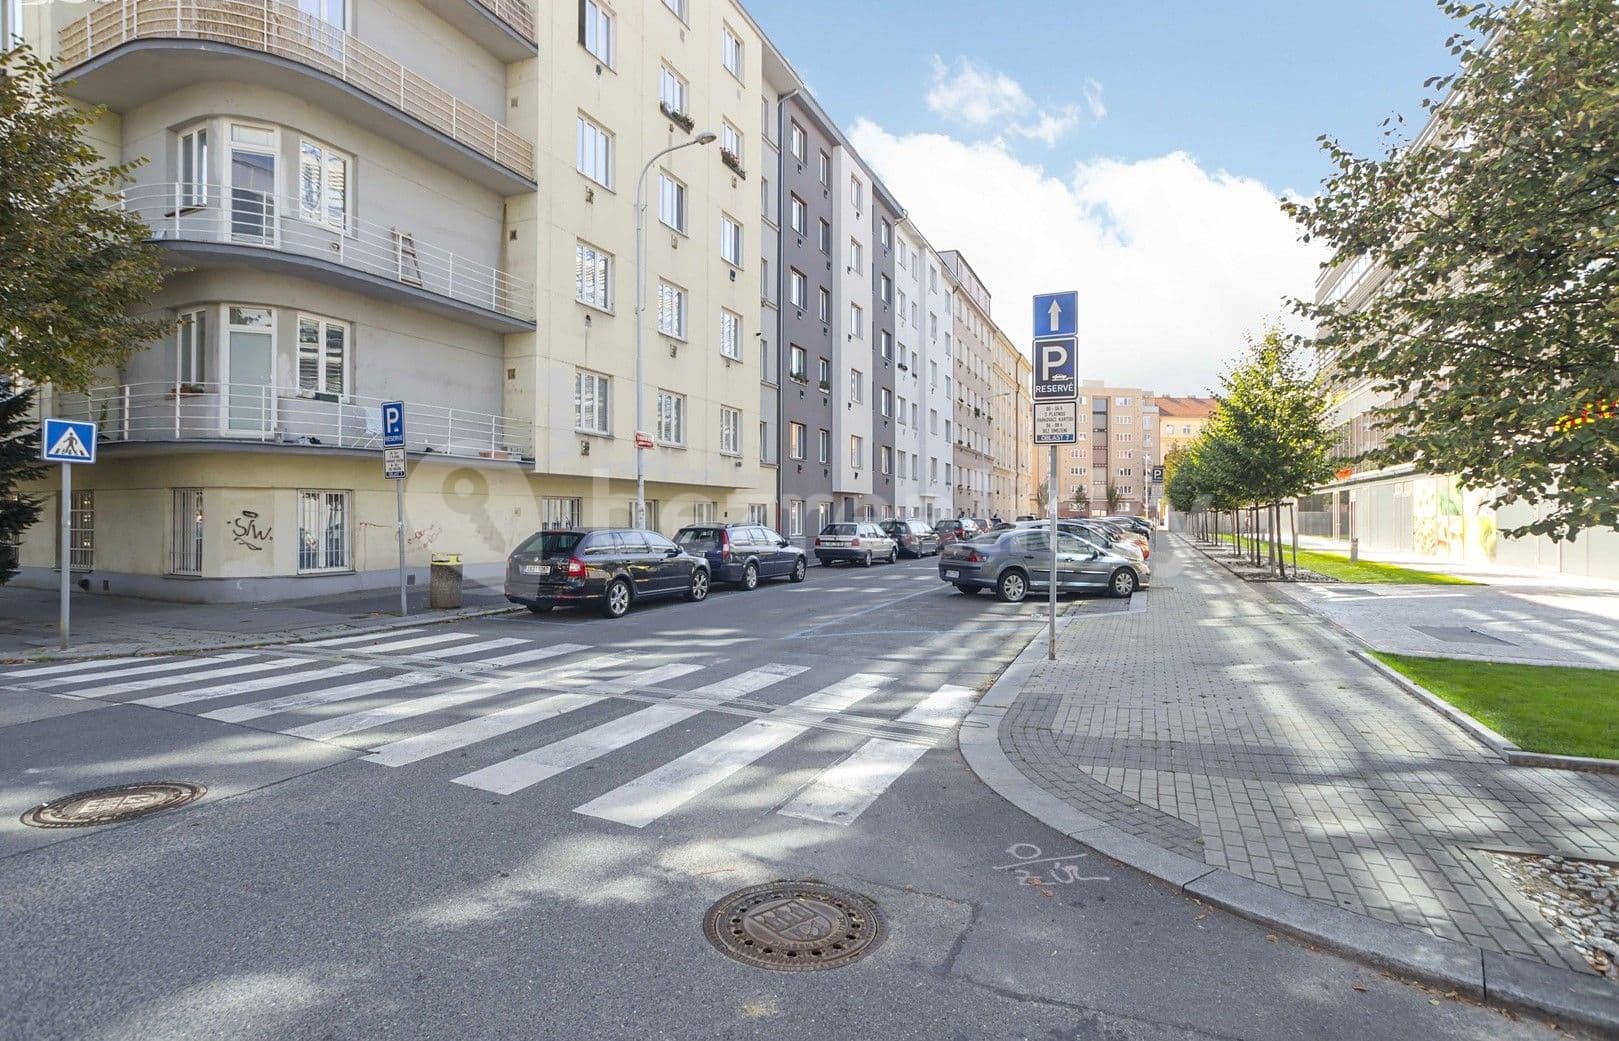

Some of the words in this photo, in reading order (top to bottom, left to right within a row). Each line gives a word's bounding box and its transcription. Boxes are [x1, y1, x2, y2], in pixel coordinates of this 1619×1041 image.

[1043, 346, 1068, 381] P
[1035, 383, 1074, 393] RESERVÉ
[386, 407, 399, 433] P
[1154, 469, 1162, 480] P
